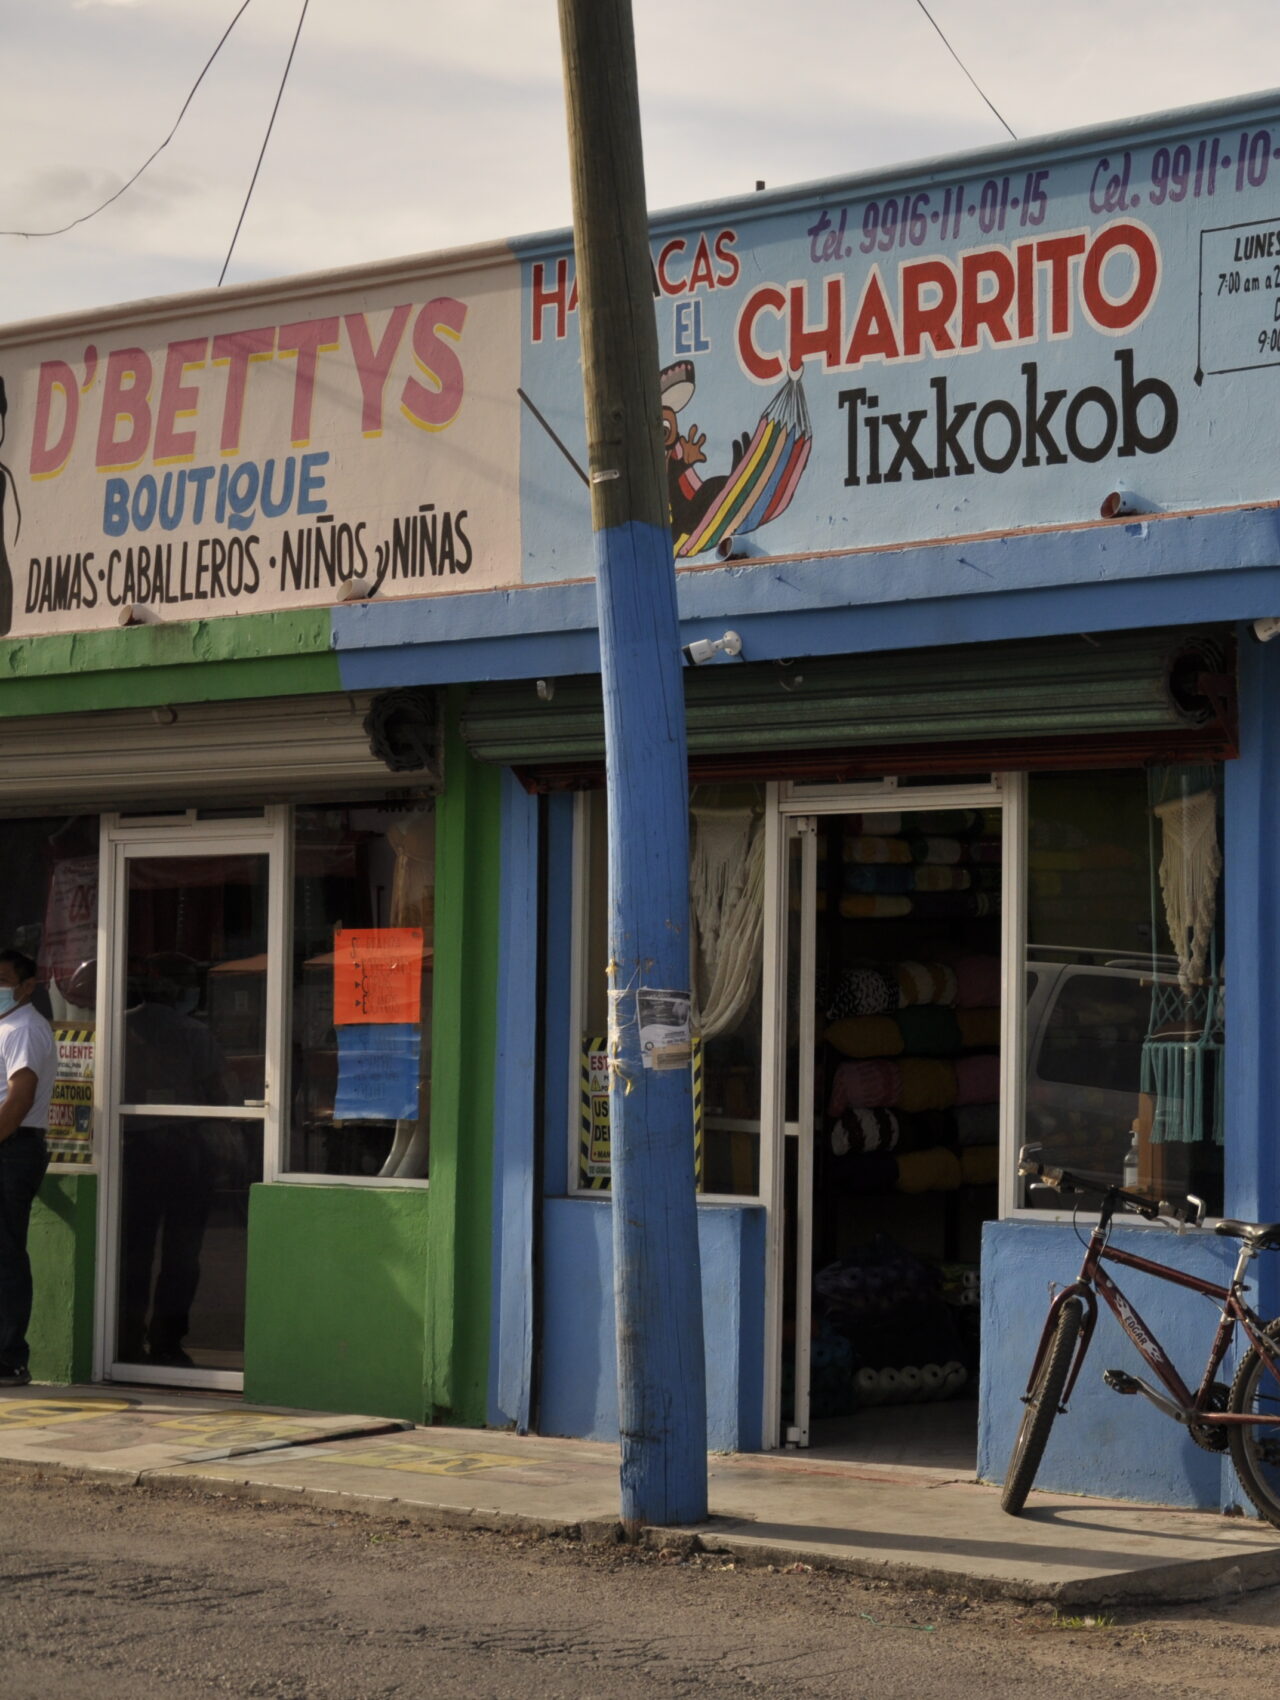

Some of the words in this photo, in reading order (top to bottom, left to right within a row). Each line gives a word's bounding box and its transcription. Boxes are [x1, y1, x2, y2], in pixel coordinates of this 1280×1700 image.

[532, 228, 741, 343] HCAS
[674, 299, 711, 355] EL
[736, 219, 1161, 384] CHARRITO
[29, 296, 468, 482] D'BETTYS
[838, 349, 1178, 487] Tixkokob
[103, 451, 329, 537] BOUTIQUE
[391, 503, 473, 581] NIÑAS
[59, 1045, 93, 1059] CLIENTE
